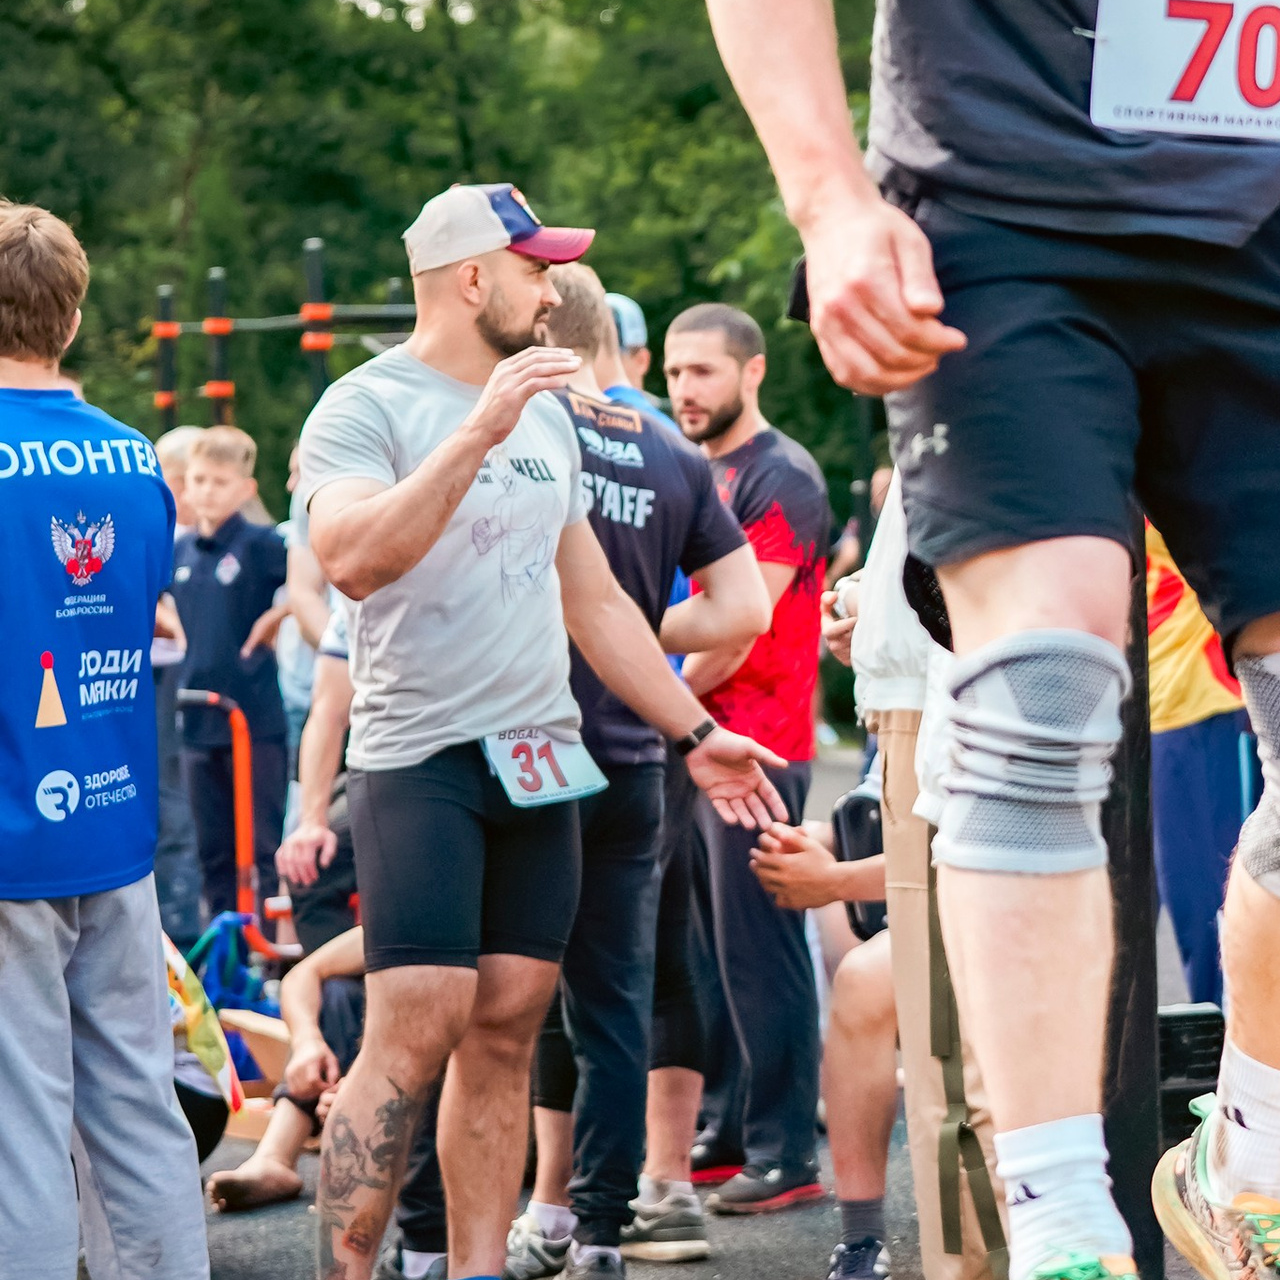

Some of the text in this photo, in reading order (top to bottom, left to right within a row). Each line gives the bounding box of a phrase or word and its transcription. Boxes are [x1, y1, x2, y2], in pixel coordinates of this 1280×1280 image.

[1113, 105, 1220, 124] СПОРТИВНЫЙ
[0, 439, 157, 479] ОЛОНТЕР
[579, 470, 656, 529] STAFF
[79, 678, 138, 707] МЯКИ
[498, 728, 539, 740] BOGAL
[511, 740, 569, 793] 31
